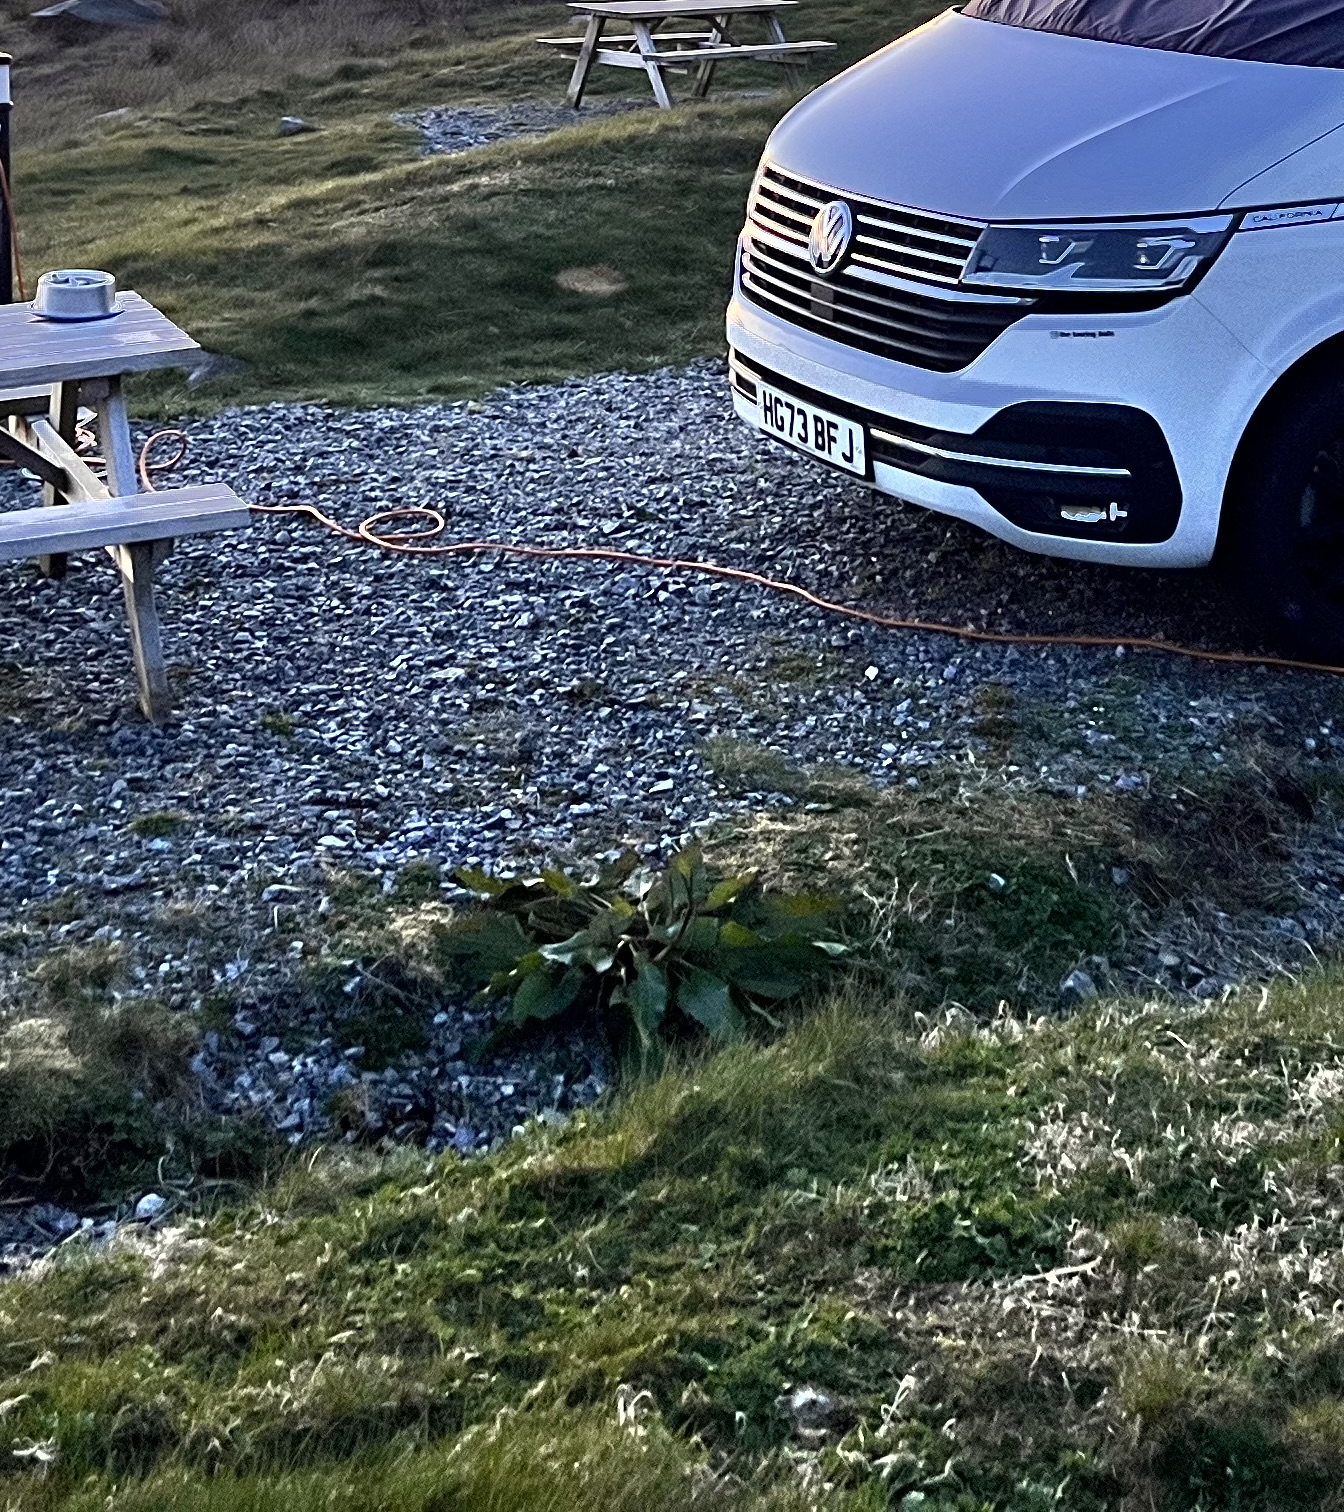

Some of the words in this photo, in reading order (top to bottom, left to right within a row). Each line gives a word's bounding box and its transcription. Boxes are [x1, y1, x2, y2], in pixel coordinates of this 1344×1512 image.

[1252, 209, 1323, 223] CALIFORNIA
[762, 389, 809, 444] HG73
[812, 414, 854, 464] BFJ
